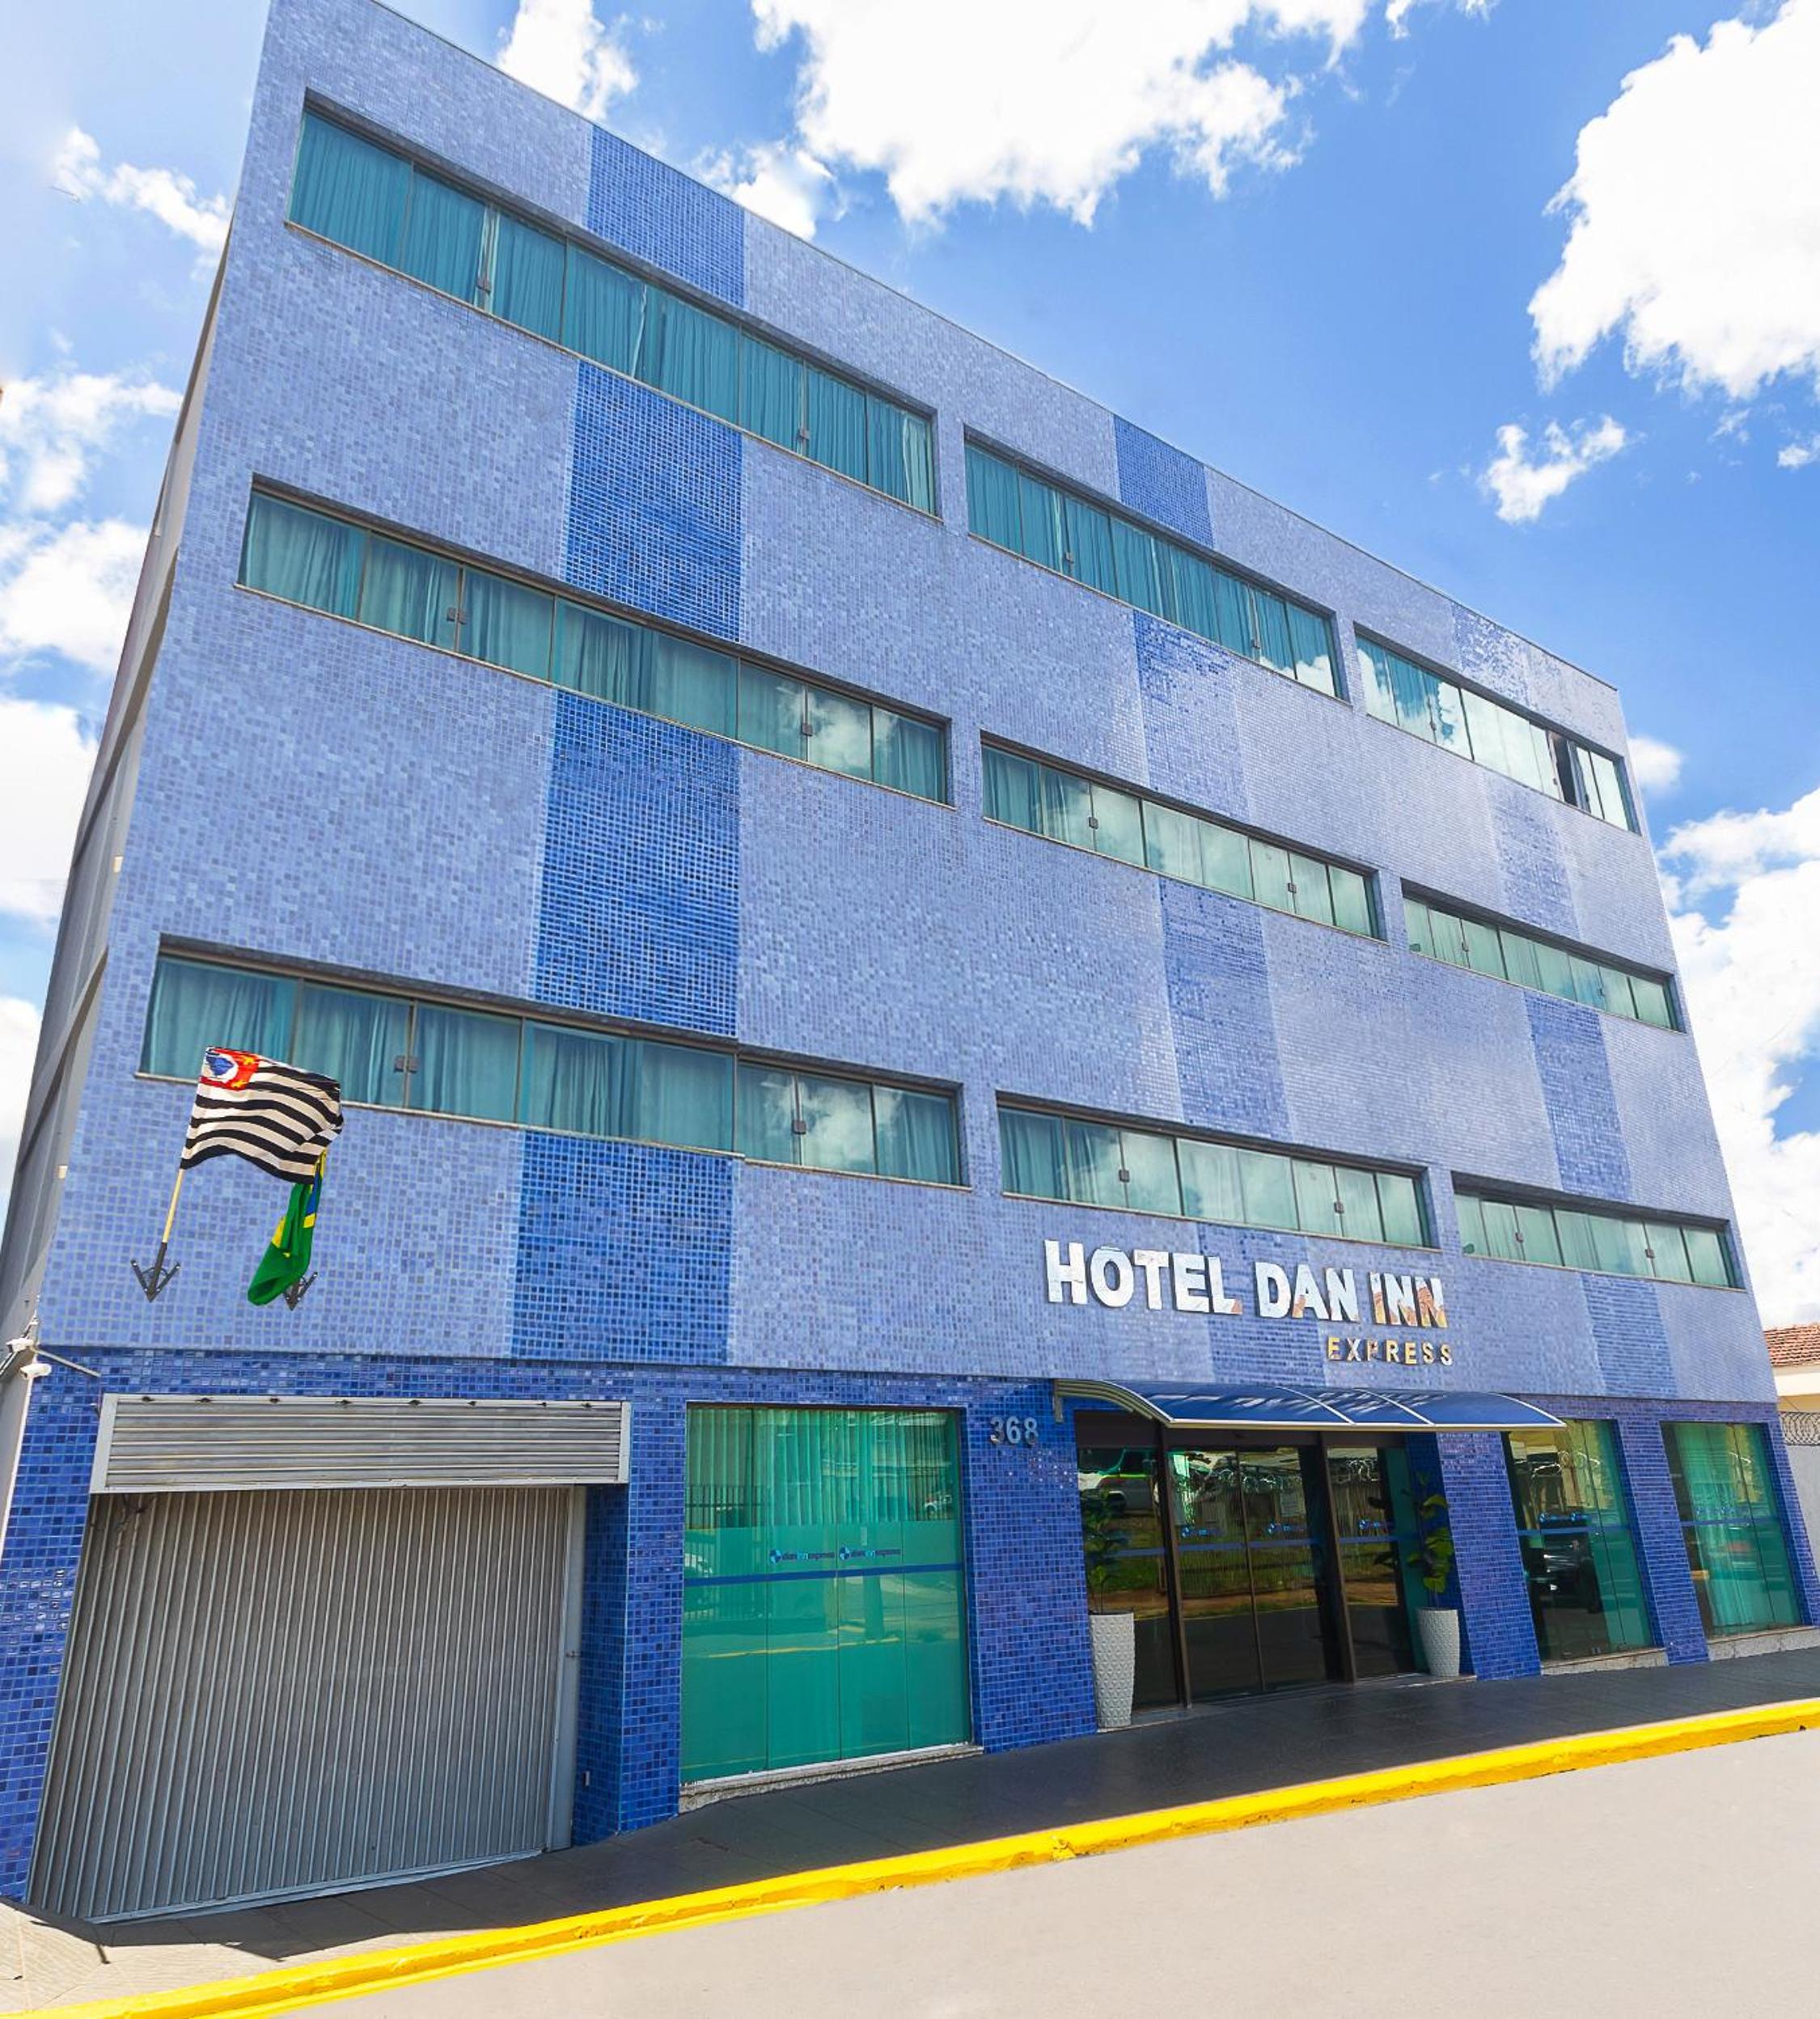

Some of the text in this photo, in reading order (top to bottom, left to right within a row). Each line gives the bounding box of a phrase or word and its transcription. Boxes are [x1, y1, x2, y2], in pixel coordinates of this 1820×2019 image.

[1043, 1239, 1448, 1328] HOTEL DAN INN
[1327, 1337, 1453, 1366] EXPRESS
[989, 1416, 1039, 1446] 368
